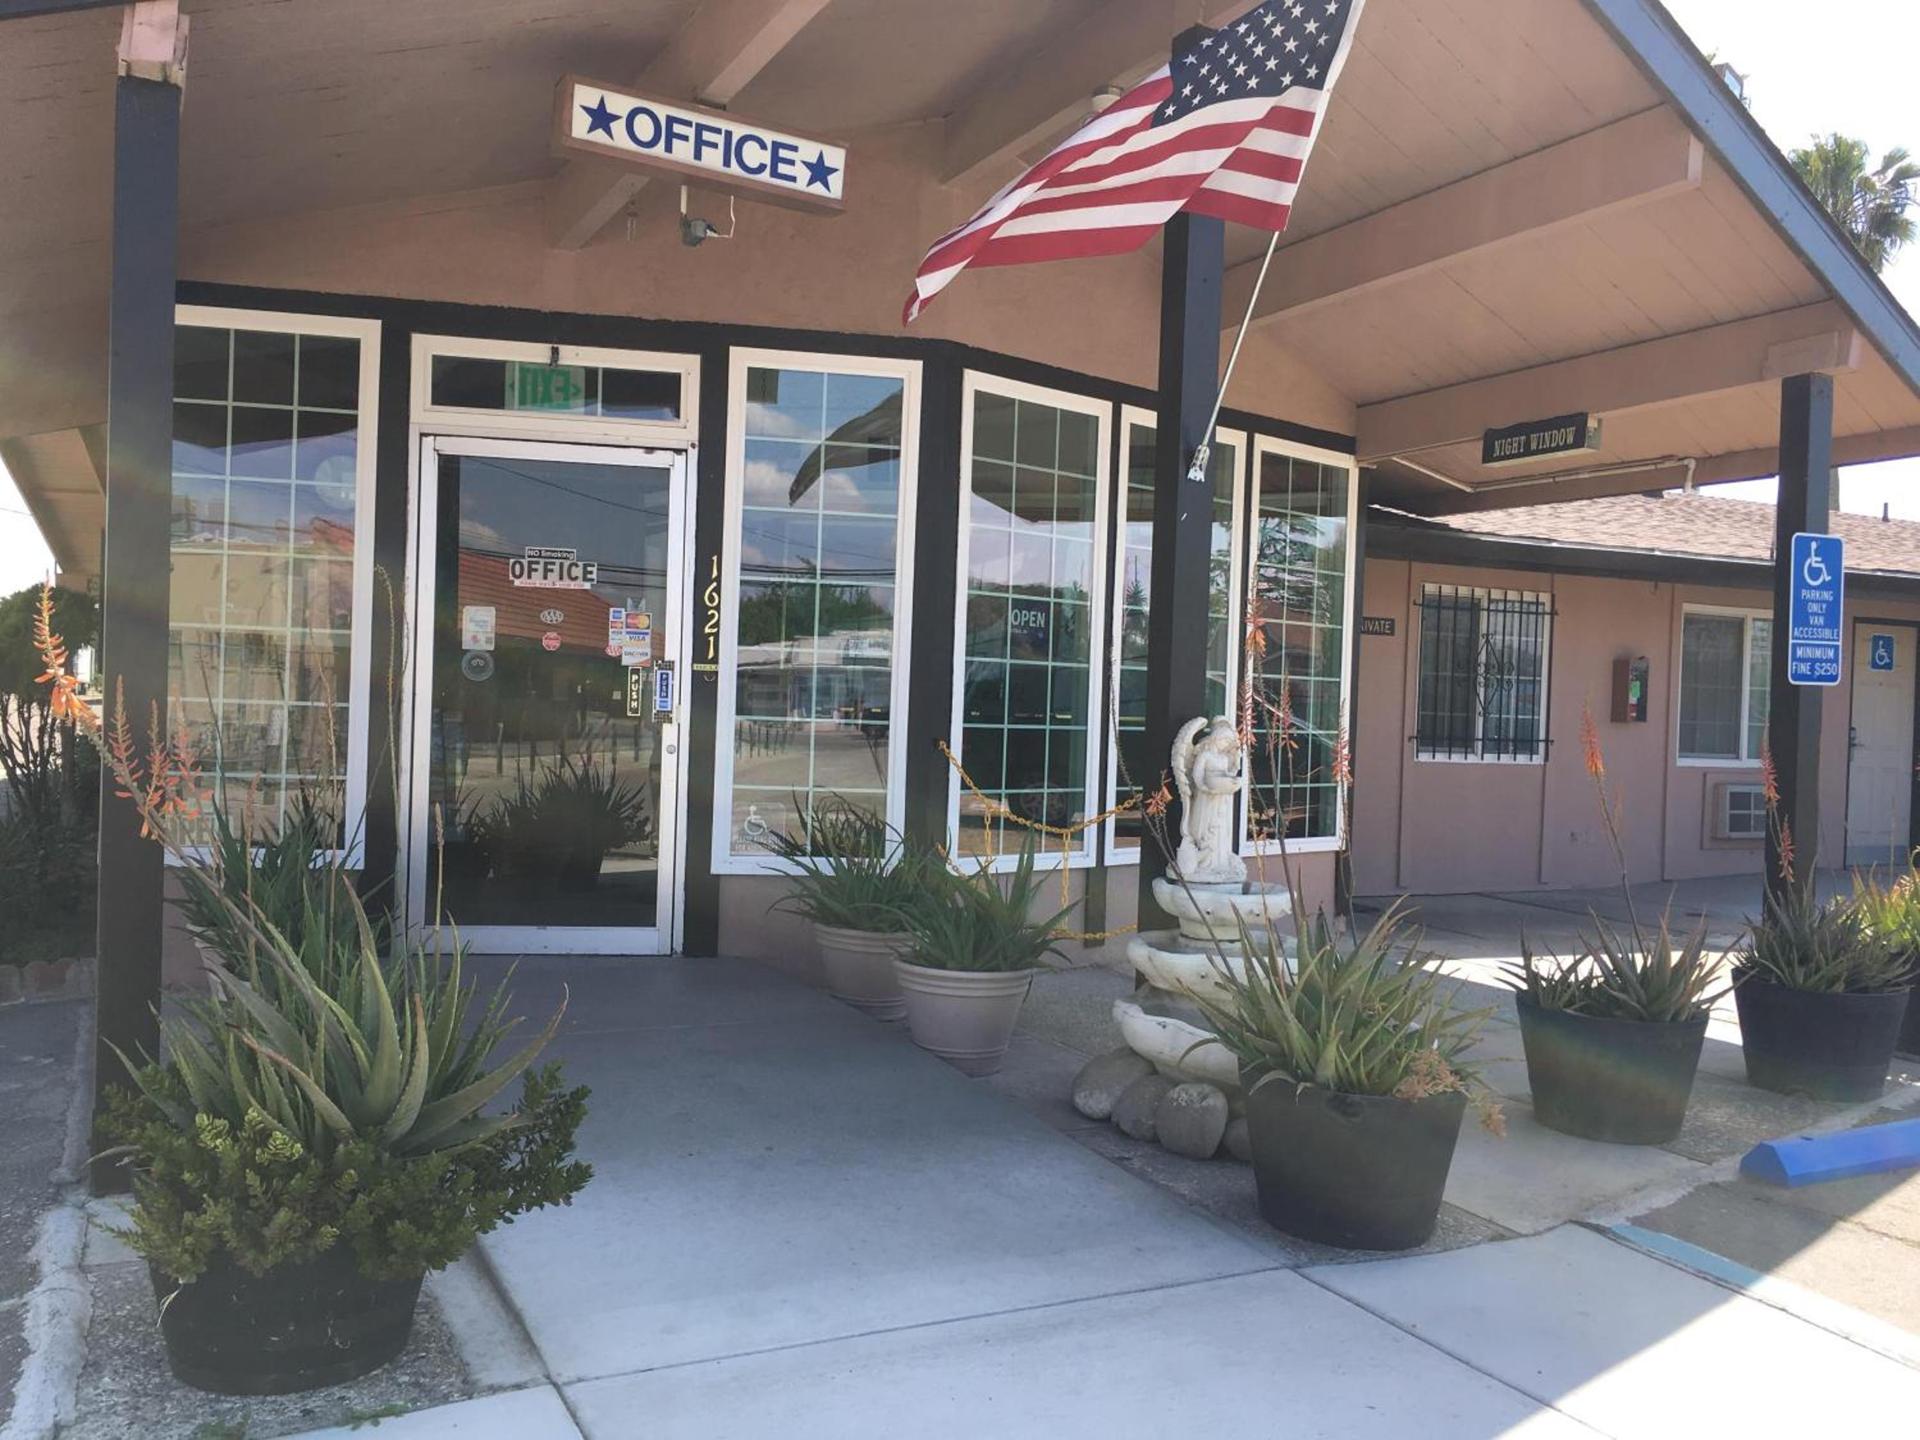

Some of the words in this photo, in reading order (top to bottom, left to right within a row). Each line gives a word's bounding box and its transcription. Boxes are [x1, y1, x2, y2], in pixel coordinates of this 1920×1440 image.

[625, 106, 799, 183] OFFICE
[1493, 436, 1526, 457] NIGHT
[1530, 427, 1576, 450] WINDOW
[511, 560, 596, 583] OFFICE
[1801, 589, 1834, 601] PARKING
[704, 555, 719, 660] 1621
[1807, 602, 1827, 614] ONLY
[1011, 608, 1046, 628] OPEN
[1809, 616, 1825, 626] VAN
[1360, 620, 1392, 634] IVATE
[1793, 627, 1839, 640] ACCESSIBLE
[1796, 646, 1835, 660] MINIMUM
[1792, 662, 1811, 675] FINE
[1814, 663, 1838, 676] $250
[631, 674, 639, 708] PUSH
